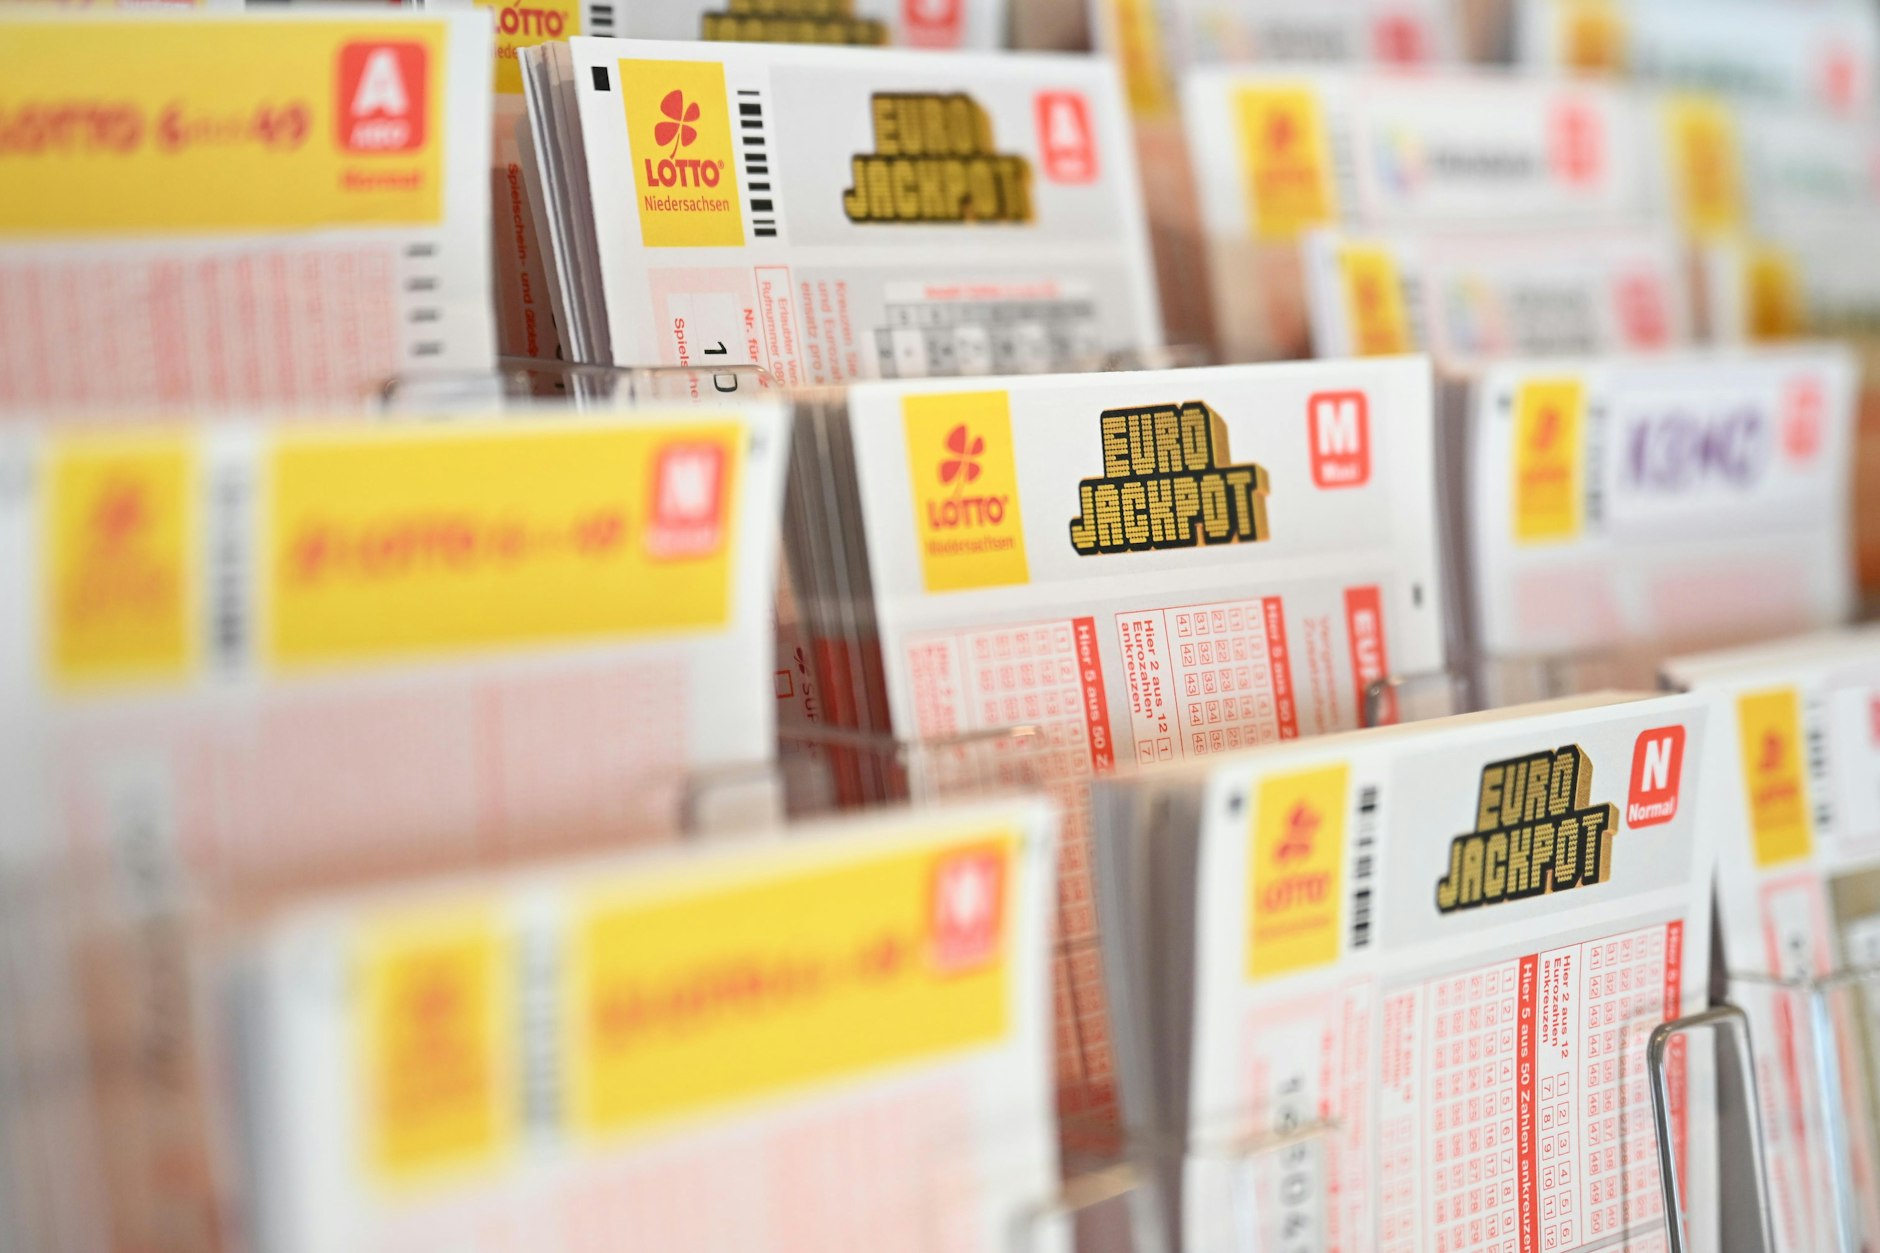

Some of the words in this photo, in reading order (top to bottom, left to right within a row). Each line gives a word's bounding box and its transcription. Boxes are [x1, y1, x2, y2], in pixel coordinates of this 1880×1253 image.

[350, 47, 410, 118] A
[844, 156, 1022, 221] JACKPOT
[644, 195, 730, 212] Niedersachsen
[521, 272, 534, 305] und
[744, 308, 755, 334] Nr.
[761, 281, 780, 357] Rufnummer
[747, 338, 760, 363] für
[1316, 401, 1359, 456] M
[1101, 405, 1214, 478] EURO
[1070, 468, 1260, 551] JACKPOT
[1179, 615, 1188, 634] 41
[1196, 615, 1206, 631] 31
[1078, 624, 1092, 663] Hier
[1144, 619, 1155, 655] Hier
[1183, 645, 1192, 664] 42
[1200, 643, 1210, 662] 32
[1121, 622, 1141, 713] ankreuzen
[1133, 620, 1153, 718] Eurozahlen
[1150, 660, 1160, 671] 2
[1152, 676, 1163, 708] aus
[1186, 675, 1197, 694] 43
[1204, 673, 1214, 692] 33
[1087, 687, 1100, 721] aus
[1190, 704, 1200, 724] 44
[1207, 702, 1217, 721] 34
[1157, 713, 1168, 733] 12
[1092, 726, 1106, 749] 50
[1194, 734, 1204, 753] 45
[1211, 731, 1221, 750] 35
[1641, 737, 1674, 793] N
[1477, 750, 1580, 832] EURO
[1628, 797, 1676, 823] Normal
[1437, 810, 1608, 911] JACKPOT
[1592, 949, 1599, 965] 41
[1563, 954, 1571, 988] Hier
[1521, 962, 1532, 1003] Hier
[1591, 978, 1599, 996] 42
[1543, 960, 1551, 1044] ankreuzen
[1552, 957, 1561, 1047] Eurozahlen
[1562, 993, 1570, 1003] 2
[1521, 1007, 1531, 1019] 5
[1561, 1007, 1569, 1035] aus
[1590, 1009, 1598, 1026] 43
[1520, 1027, 1530, 1058] aus
[1561, 1041, 1569, 1060] 12
[1590, 1038, 1597, 1055] 44
[1520, 1064, 1531, 1086] 50
[1589, 1067, 1597, 1085] 45
[1590, 1097, 1597, 1114] 46
[1520, 1089, 1531, 1155] Zahlen
[1590, 1126, 1598, 1142] 47
[1590, 1155, 1599, 1172] 48
[1545, 1170, 1552, 1188] 10
[1591, 1184, 1600, 1202] 49
[1546, 1200, 1553, 1216] 11
[1608, 1209, 1615, 1227] 40
[1592, 1213, 1600, 1232] 50
[1547, 1230, 1554, 1246] 12
